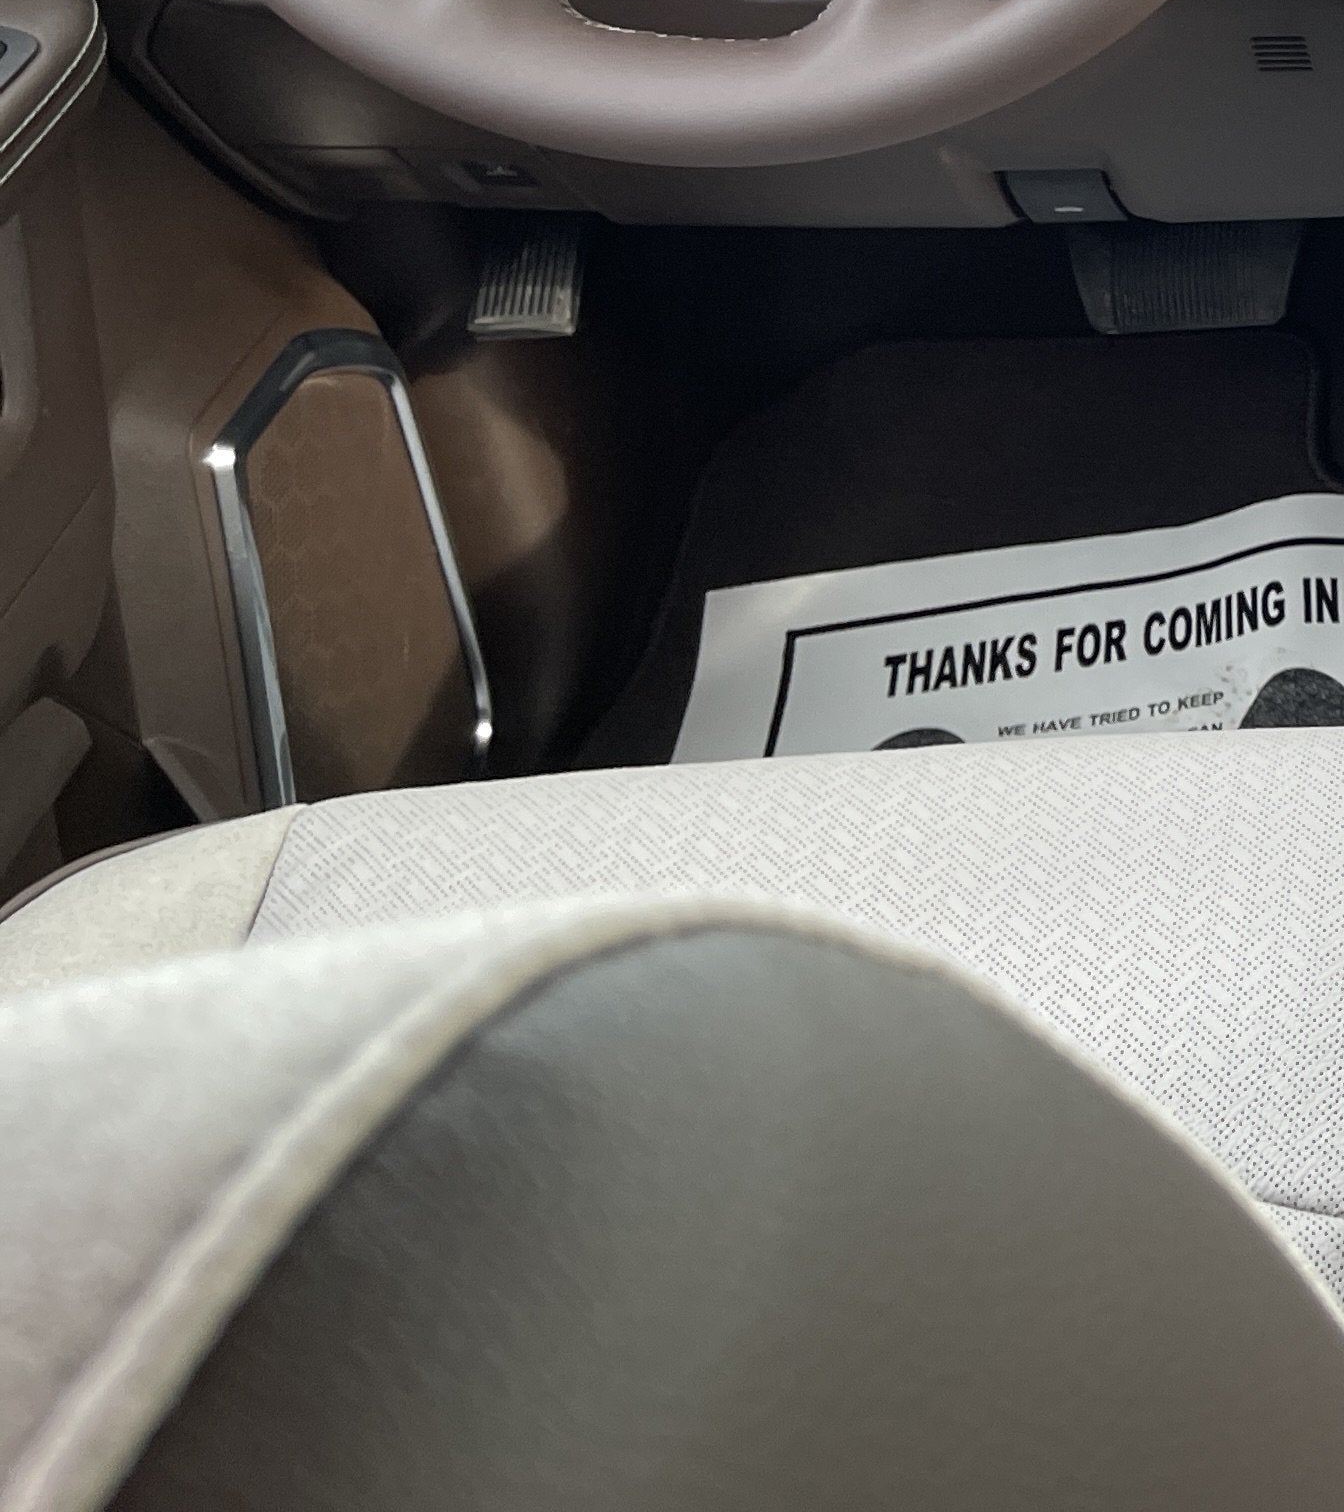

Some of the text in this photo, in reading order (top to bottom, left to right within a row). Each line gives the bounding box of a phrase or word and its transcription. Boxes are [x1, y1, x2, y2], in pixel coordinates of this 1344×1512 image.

[884, 577, 1340, 698] THANKS FOR COMING IN
[998, 691, 1224, 738] WE HAVE TRIED TO KEEP
